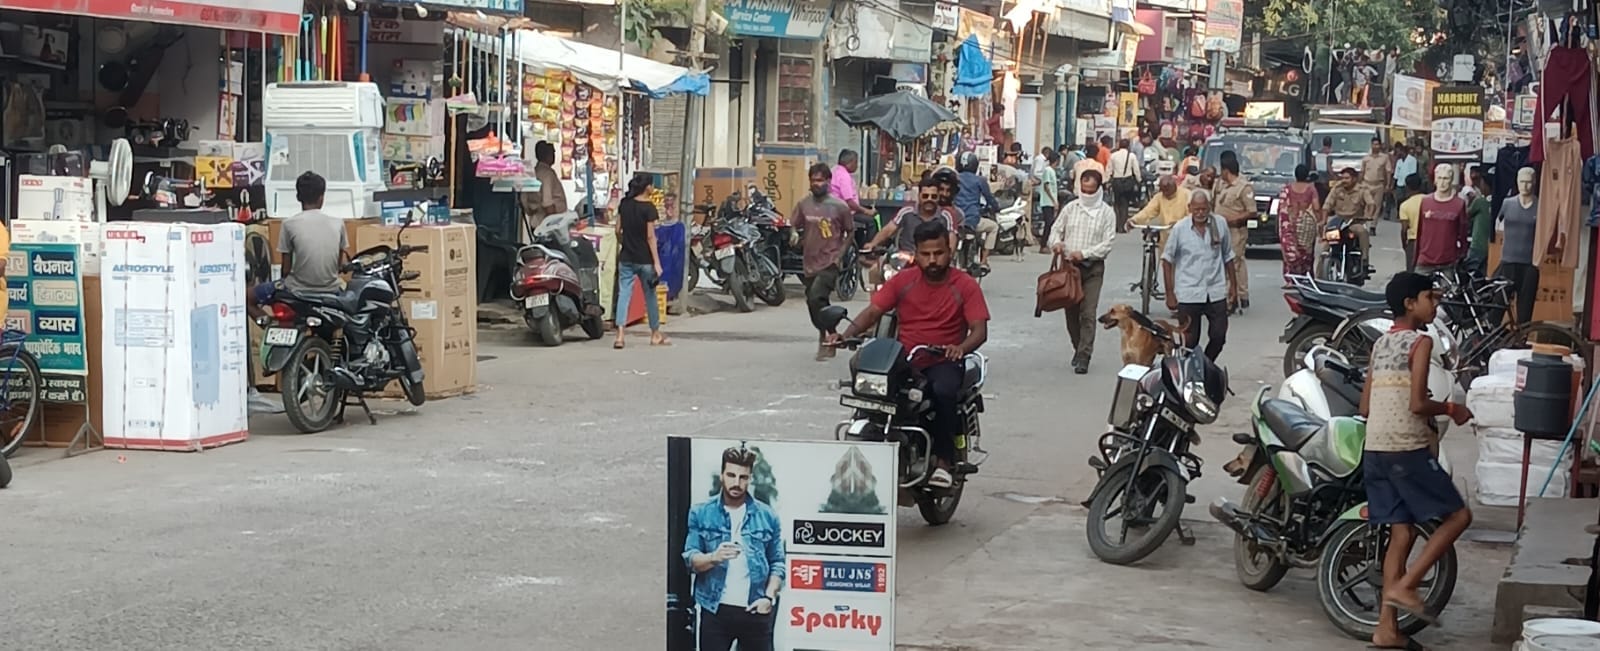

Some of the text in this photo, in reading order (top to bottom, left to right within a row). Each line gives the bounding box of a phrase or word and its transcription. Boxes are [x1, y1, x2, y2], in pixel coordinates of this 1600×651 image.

[731, 9, 753, 22] Service
[1279, 81, 1300, 97] LG
[1437, 93, 1479, 104] HARSHIT
[112, 264, 175, 273] AEROSTYLE
[38, 317, 76, 331] व्यास
[817, 528, 882, 543] JOCKEY
[823, 567, 872, 580] FLU JNS
[790, 606, 882, 636] Sparky
